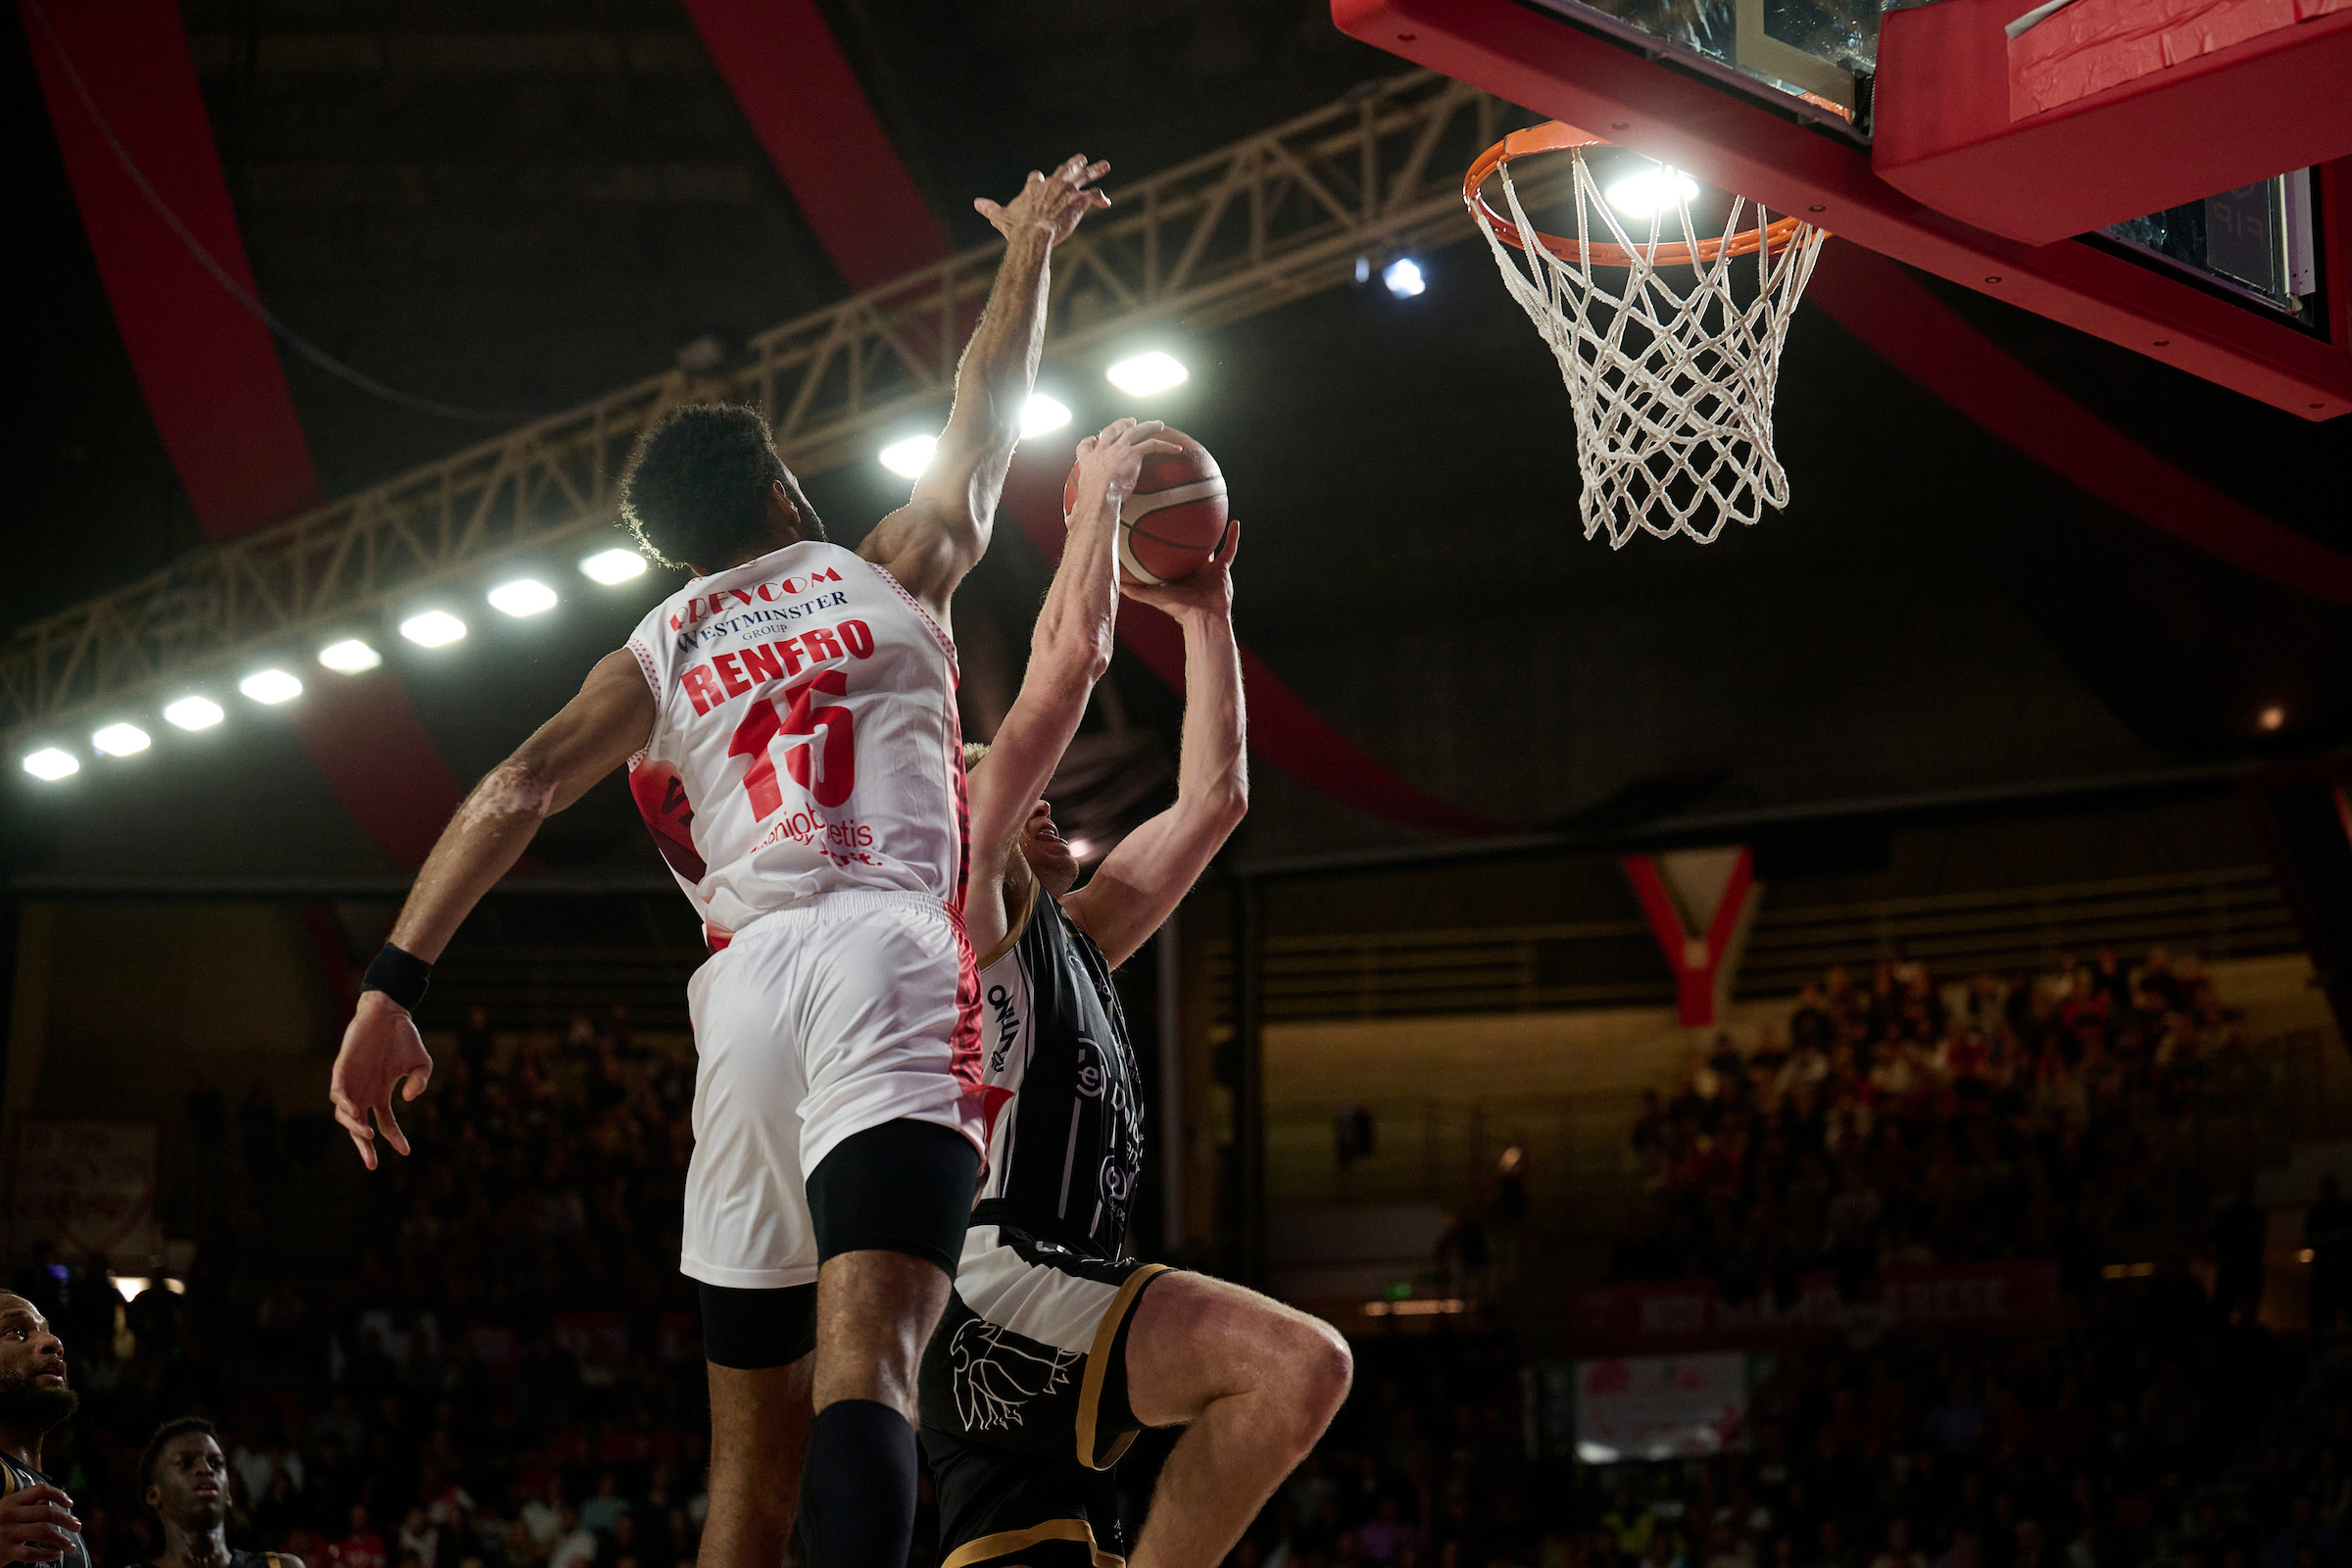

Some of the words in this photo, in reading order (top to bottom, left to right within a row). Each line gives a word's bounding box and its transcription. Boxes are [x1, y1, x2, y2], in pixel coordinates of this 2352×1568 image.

[677, 590, 849, 654] WESTMINSTER
[742, 624, 788, 641] GROUP
[680, 618, 875, 717] RENFRO
[727, 669, 856, 824] 15
